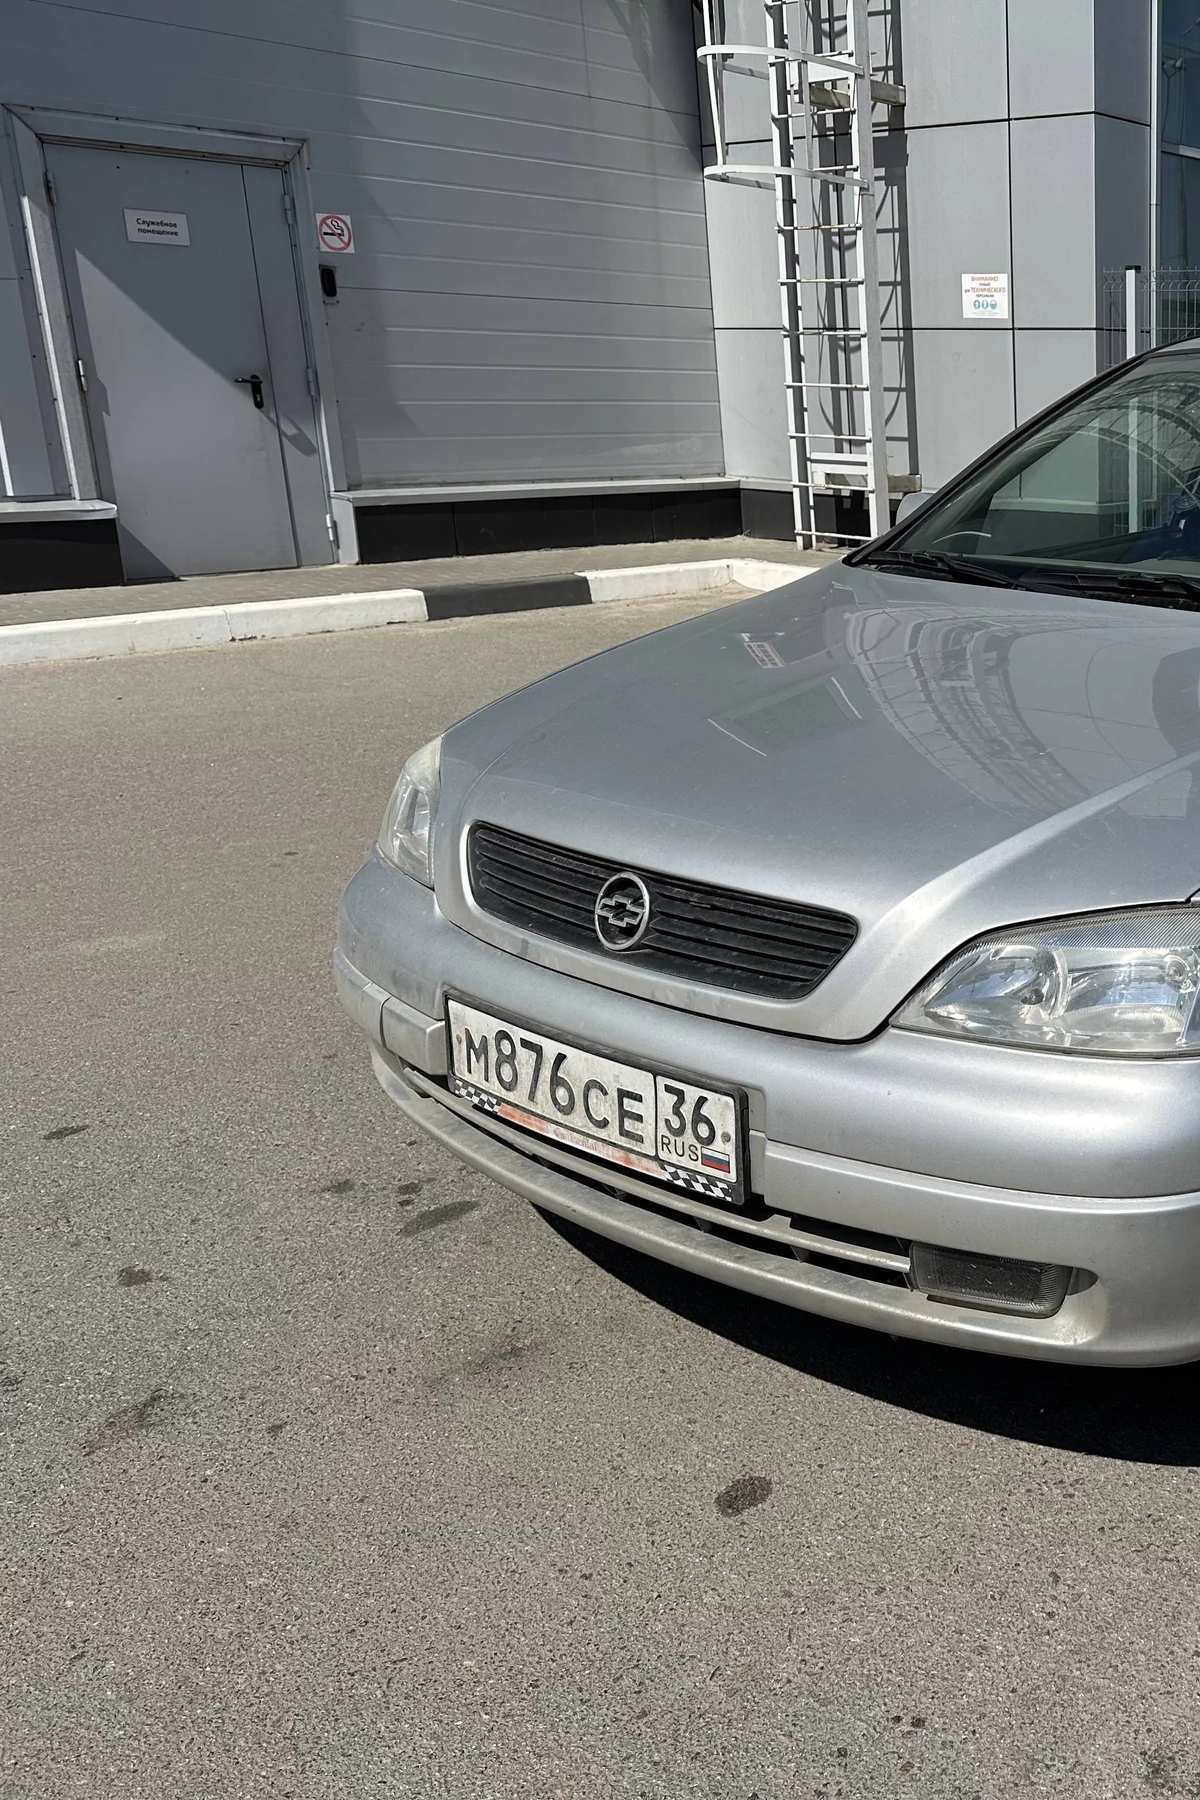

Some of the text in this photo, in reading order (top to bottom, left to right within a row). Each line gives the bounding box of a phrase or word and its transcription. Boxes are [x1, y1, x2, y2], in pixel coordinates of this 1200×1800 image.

[136, 217, 177, 228] Служебное
[137, 228, 179, 237] помещение
[464, 1026, 717, 1146] М876СЕ 36
[660, 1135, 699, 1163] RUS
